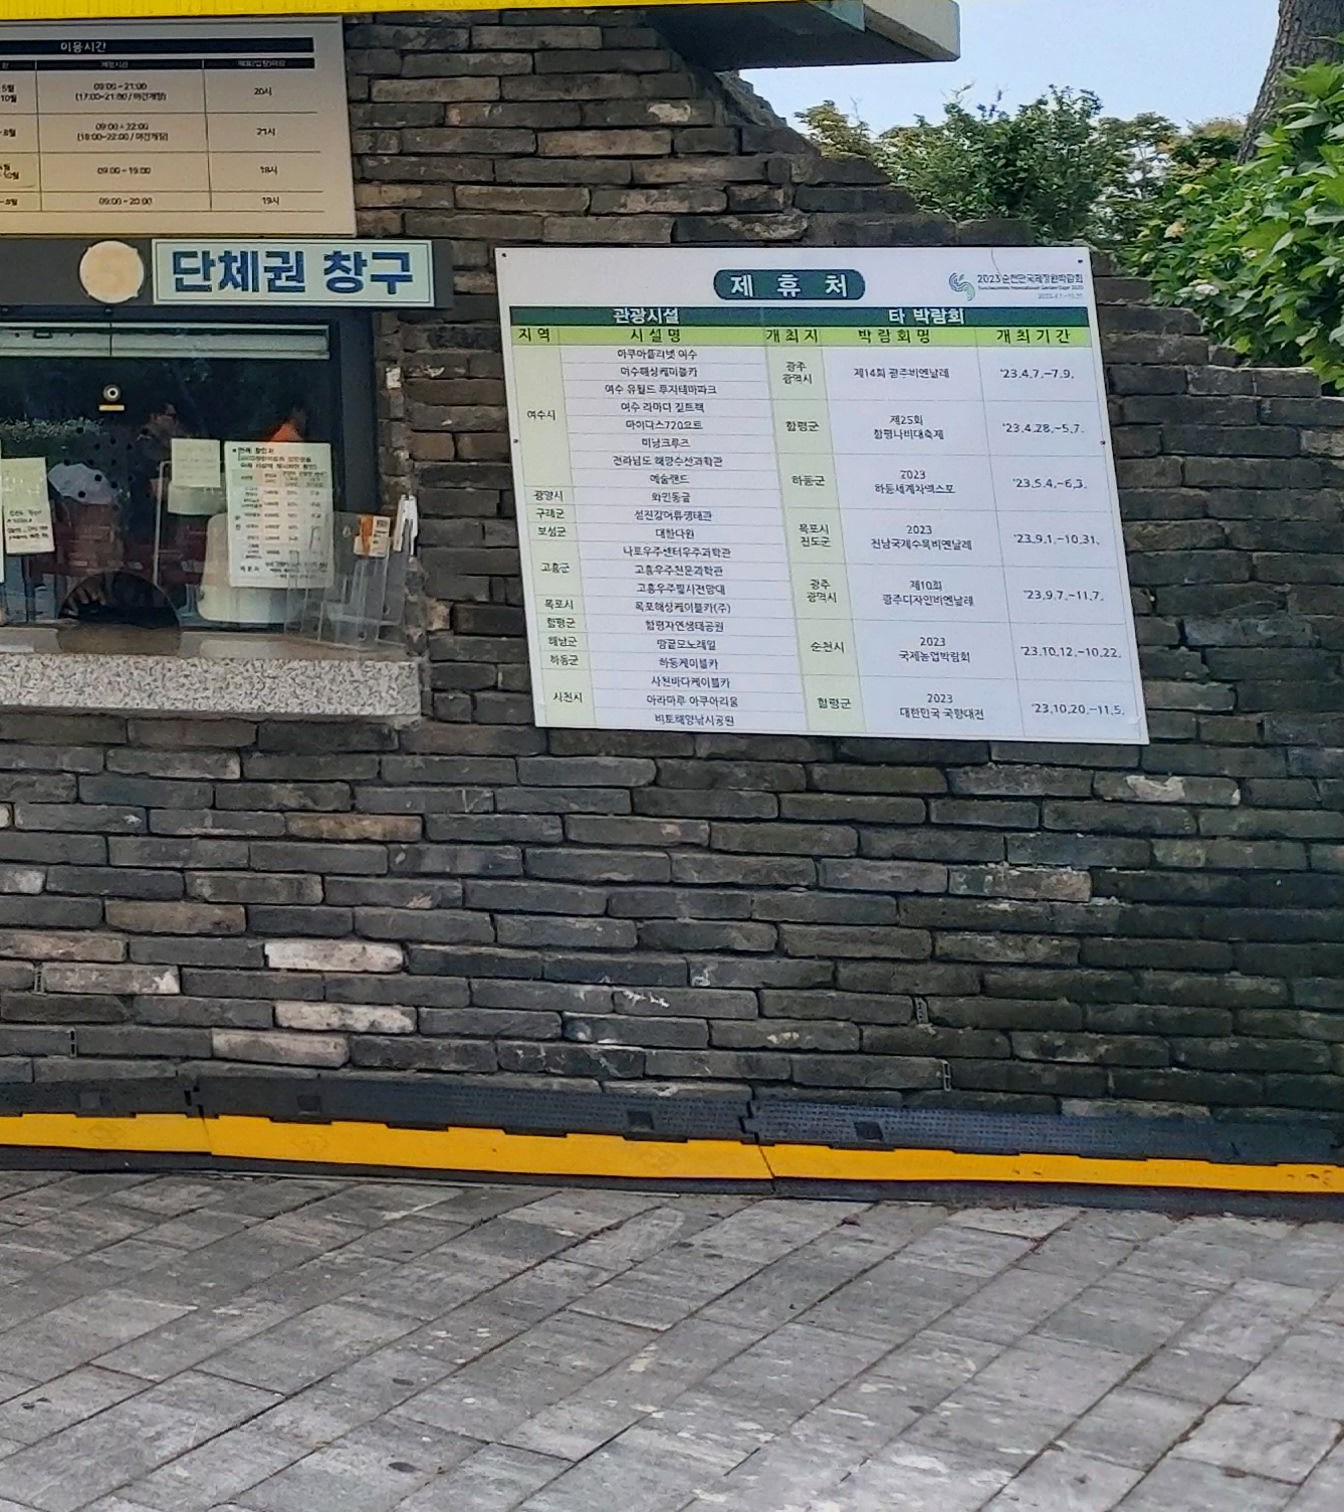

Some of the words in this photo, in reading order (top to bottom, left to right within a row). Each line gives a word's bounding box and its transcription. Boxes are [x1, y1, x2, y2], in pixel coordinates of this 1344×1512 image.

[60, 41, 107, 53] 이용시간
[254, 87, 272, 96] 20시
[172, 250, 306, 293] 단체권
[324, 250, 413, 295] 창구
[730, 272, 848, 298] 제휴처
[613, 308, 679, 324] 관광시설
[888, 309, 905, 324] 타
[913, 308, 965, 325] 박람회
[518, 327, 551, 342] 지역
[630, 328, 681, 343] 시설명
[766, 329, 818, 344] 개최지
[858, 329, 931, 344] 박람회명
[996, 329, 1071, 344] 개최기간
[526, 409, 556, 421] 여수시
[889, 415, 924, 427] 제25회
[900, 469, 926, 480] 2023
[906, 524, 933, 535] 2023
[810, 641, 846, 654] 순천시
[919, 636, 947, 647] 2023
[926, 693, 953, 704] 2023
